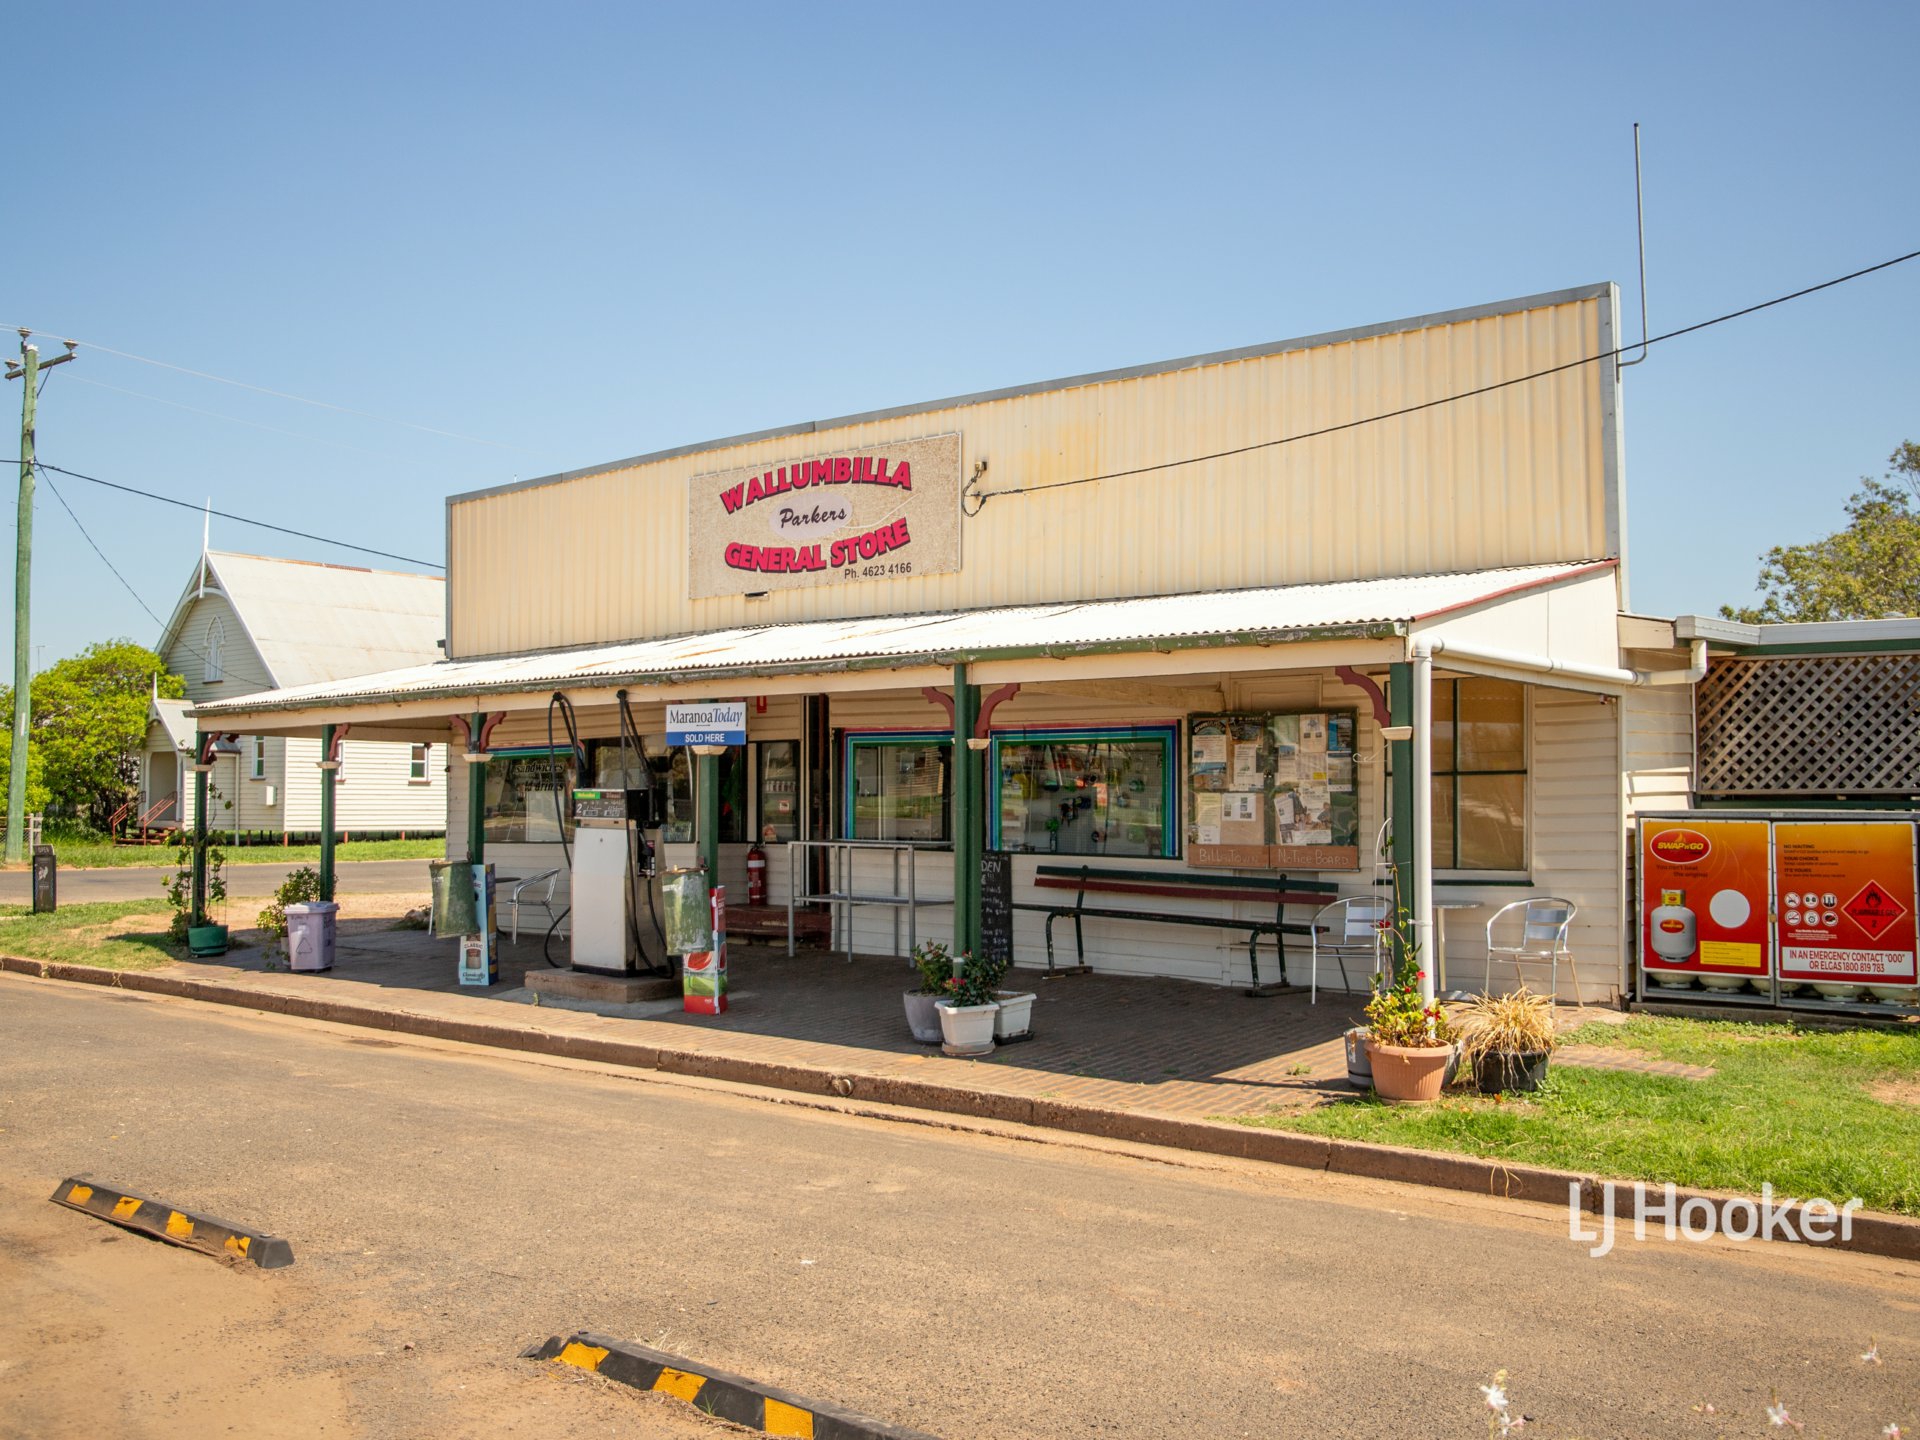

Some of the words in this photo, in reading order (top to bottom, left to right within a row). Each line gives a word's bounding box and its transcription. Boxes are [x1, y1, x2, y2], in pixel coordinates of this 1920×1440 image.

[719, 456, 912, 515] WALLUMBILLA
[779, 505, 847, 528] Parkers
[724, 541, 827, 573] GENERAL
[830, 517, 911, 568] STORE
[844, 568, 860, 580] Ph.
[862, 564, 886, 577] 4623
[887, 562, 912, 575] 4166
[685, 733, 704, 743] SOLD
[704, 733, 725, 743] HERE
[534, 781, 564, 791] drins
[576, 803, 582, 814] 2
[1790, 950, 1797, 959] IN
[1798, 950, 1808, 959] AN
[1809, 951, 1850, 961] EMERGENCY
[1851, 952, 1884, 962] CONTACT
[1809, 961, 1819, 970] OR
[1820, 961, 1842, 971] ELGAS
[1843, 962, 1859, 972] 1800
[1860, 963, 1872, 972] 819
[1872, 963, 1885, 973] 783
